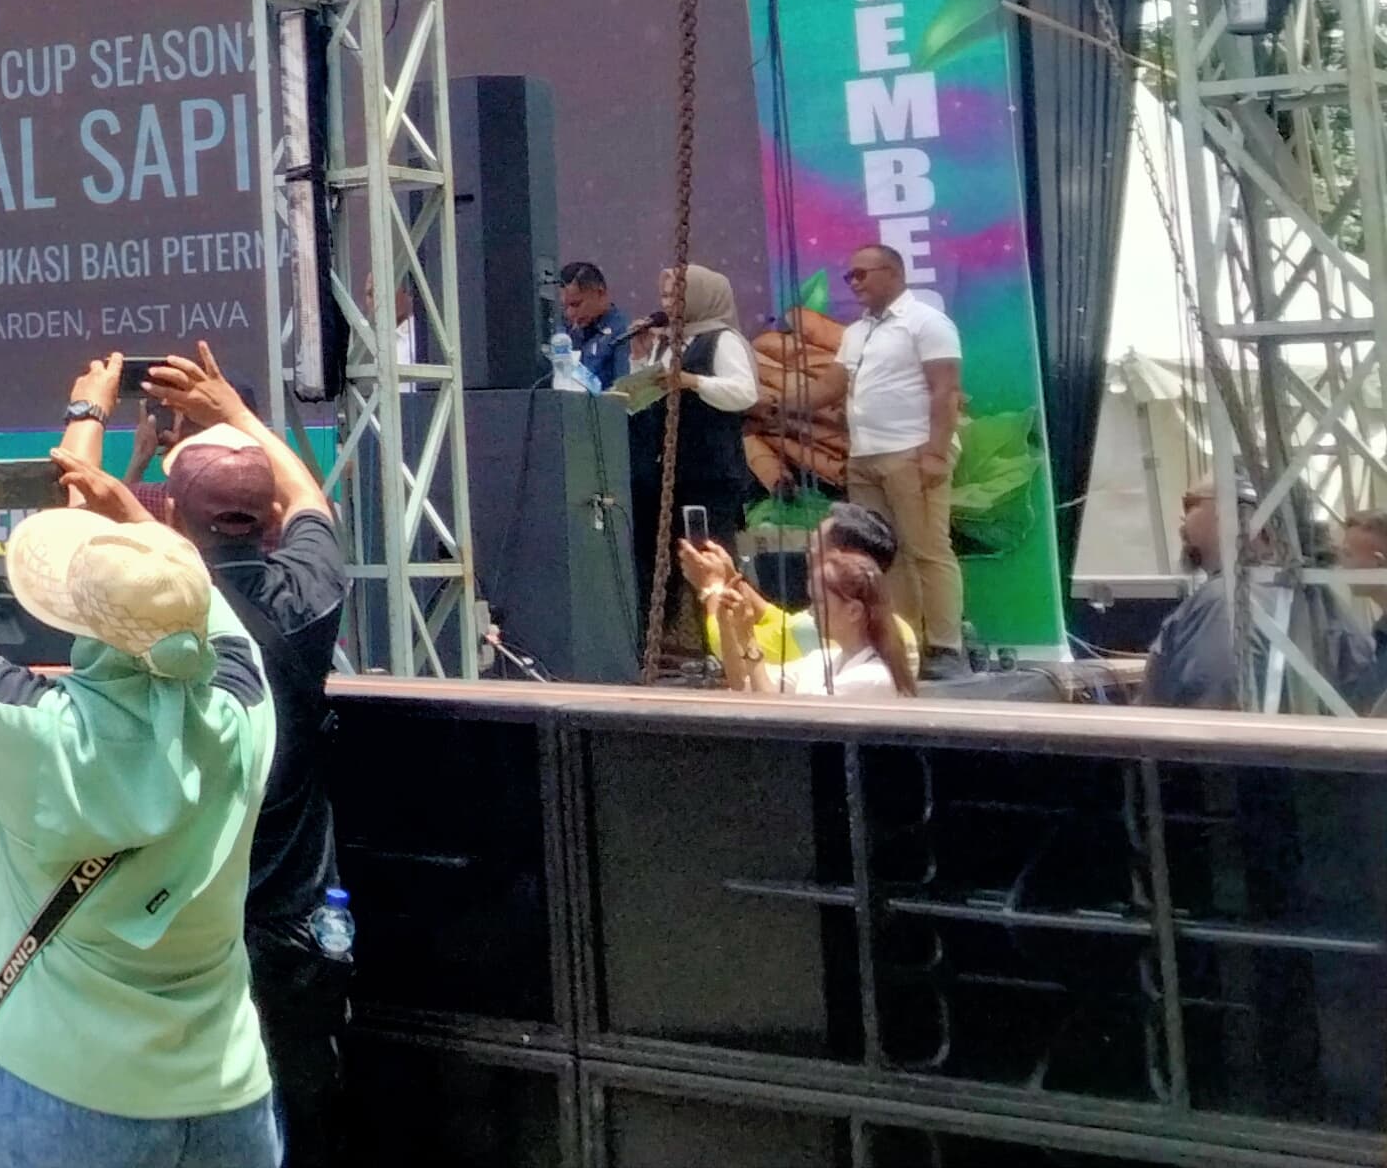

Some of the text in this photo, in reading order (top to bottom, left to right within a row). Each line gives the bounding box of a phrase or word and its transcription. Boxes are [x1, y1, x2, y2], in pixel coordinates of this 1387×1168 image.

[0, 43, 77, 101] CUP
[80, 93, 252, 206] SAPI
[81, 238, 151, 281] BAGI
[162, 228, 293, 276] PETERNA
[102, 303, 171, 335] EAST
[177, 299, 249, 338] JAVA
